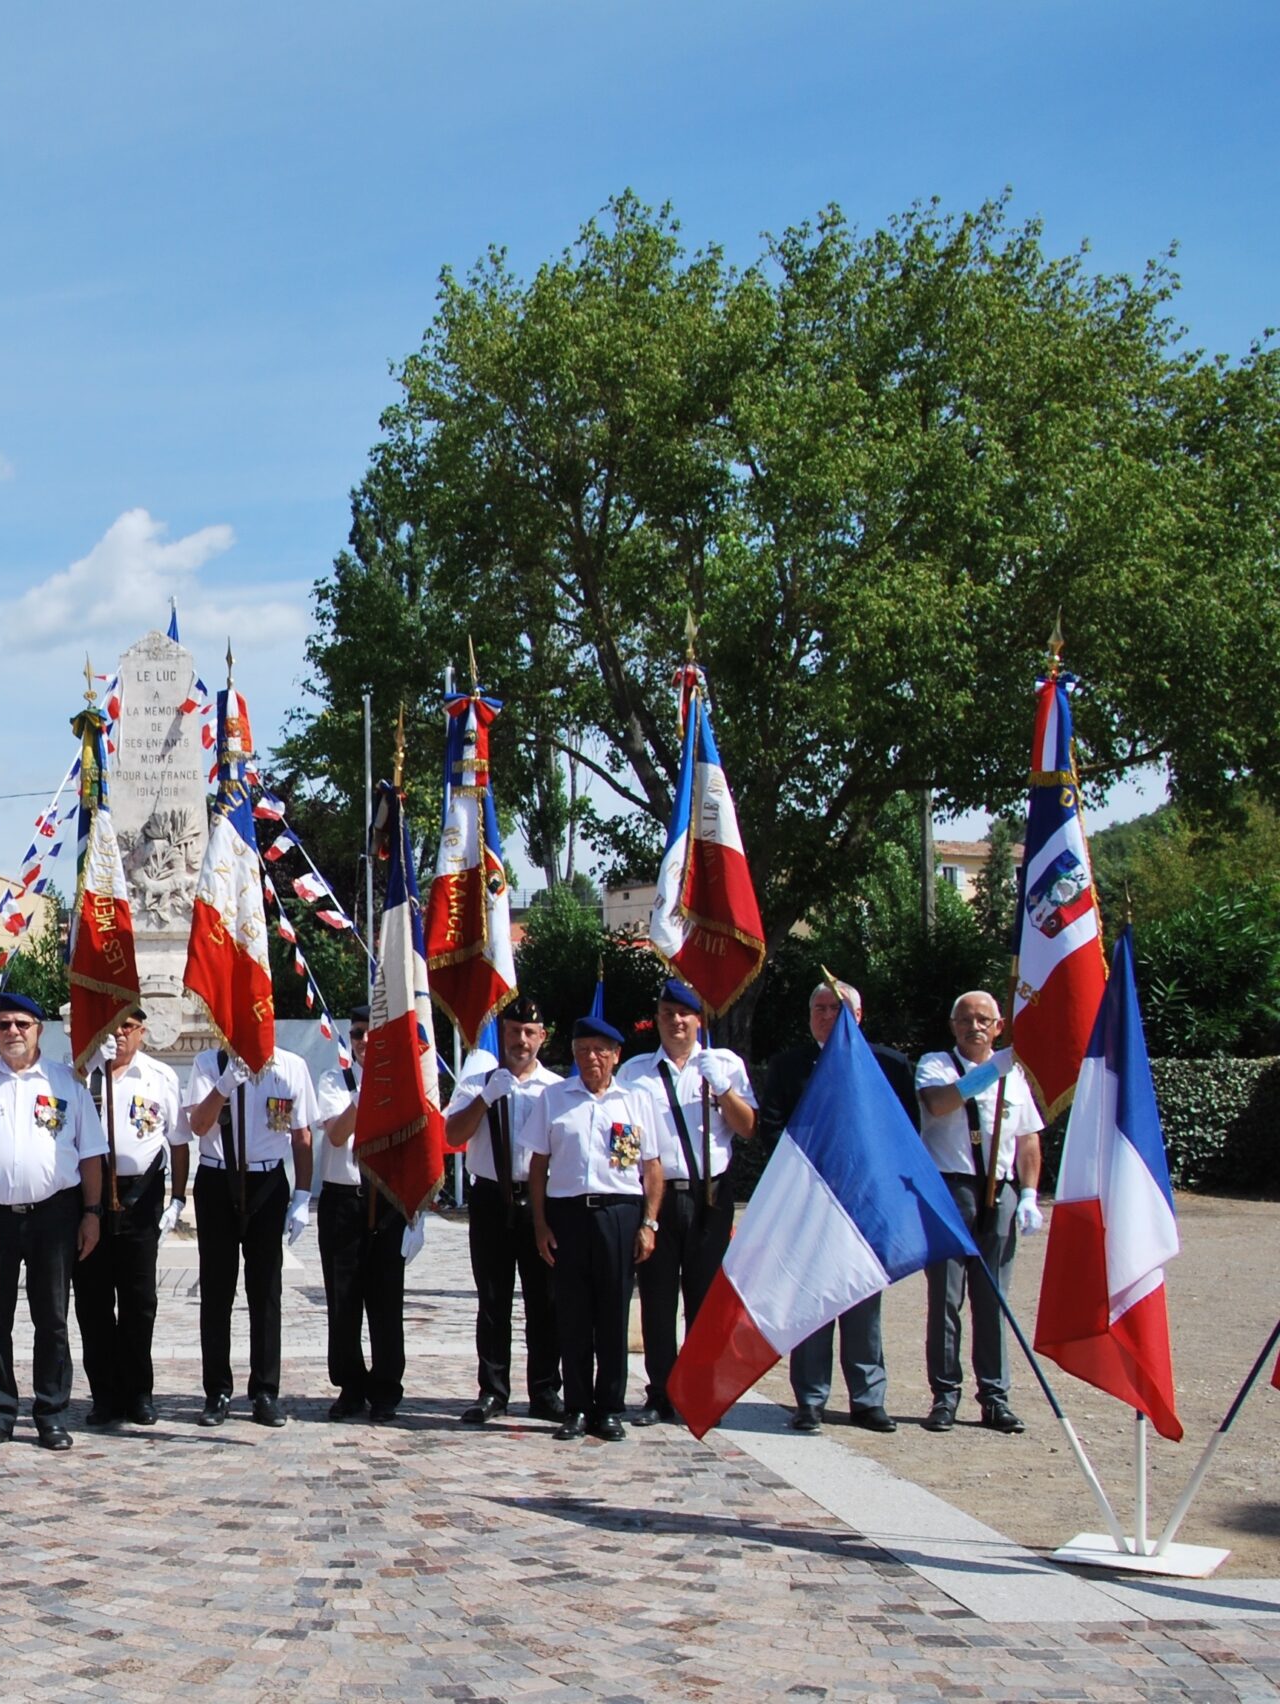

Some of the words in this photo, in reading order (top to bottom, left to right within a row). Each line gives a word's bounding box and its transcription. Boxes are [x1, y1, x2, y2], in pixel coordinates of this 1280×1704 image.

[137, 671, 151, 682] LE
[156, 671, 177, 682] LUC
[126, 707, 140, 717] LA
[151, 722, 162, 732] DE
[125, 738, 142, 748] SES
[146, 738, 190, 748] ENFANTS
[141, 754, 173, 765] MORTS
[115, 770, 141, 781] POUR
[144, 771, 158, 781] LA
[161, 770, 198, 781] FRANCE
[702, 802, 719, 822] LE
[445, 854, 468, 944] FRANCE
[103, 938, 127, 976] LES
